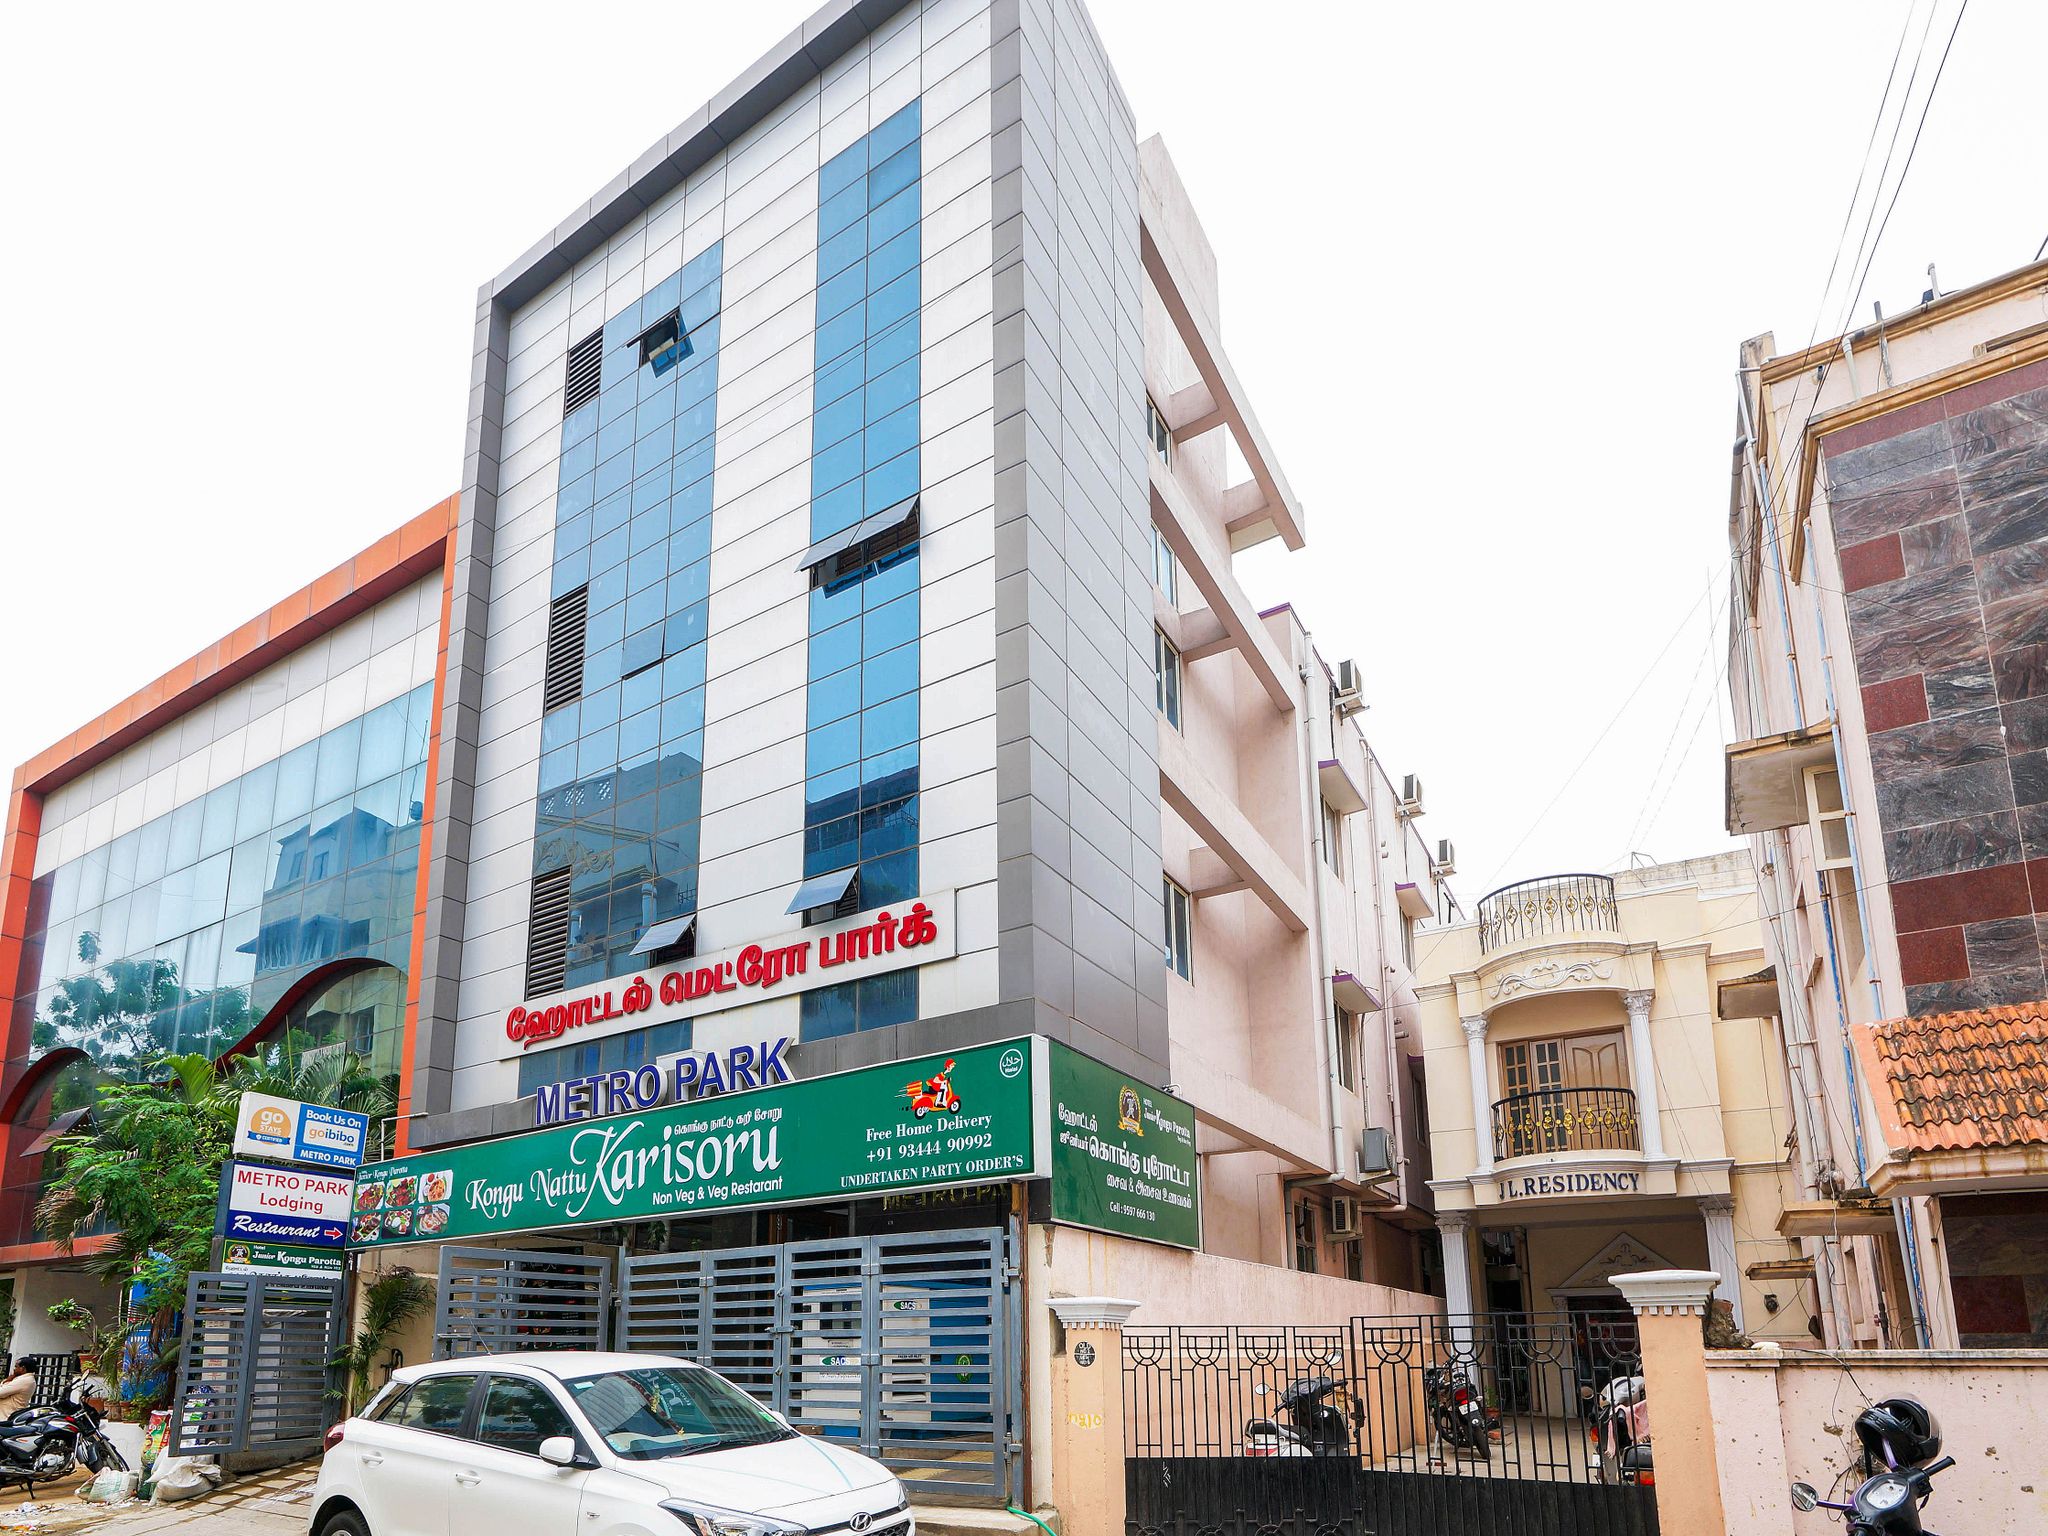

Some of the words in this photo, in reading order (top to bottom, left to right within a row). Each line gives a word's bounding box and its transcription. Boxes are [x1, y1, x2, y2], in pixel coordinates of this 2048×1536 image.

[505, 976, 653, 1050] ஹோட்டல்
[659, 941, 811, 1006] மெட்ரோ
[818, 902, 938, 968] பார்க்
[536, 1064, 666, 1125] METRO
[674, 1037, 795, 1100] PARK
[259, 1124, 282, 1135] STAYS
[260, 1110, 284, 1125] go
[306, 1109, 332, 1123] Book
[333, 1113, 346, 1126] Us
[347, 1117, 362, 1128] On
[866, 1127, 892, 1142] Free
[895, 1122, 933, 1139] Home
[937, 1114, 993, 1133] Delivery
[308, 1127, 355, 1143] goibibo
[866, 1147, 893, 1163] +91
[898, 1140, 941, 1158] 93444
[946, 1132, 993, 1152] 90992
[300, 1149, 331, 1162] METRO
[333, 1155, 357, 1166] PARK
[1088, 1135, 1141, 1174] கொங்கு
[464, 1178, 524, 1220] Kongu
[529, 1167, 588, 1207] Nattu
[565, 1120, 784, 1218] Karisoru
[840, 1167, 919, 1188] UNDERTAKEN
[921, 1161, 963, 1180] PARTY
[237, 1170, 300, 1190] METRO
[304, 1179, 349, 1197] PARK
[652, 1190, 674, 1206] Non
[674, 1188, 695, 1205] Veg
[697, 1187, 706, 1200] &
[707, 1184, 728, 1201] Veg
[730, 1175, 784, 1196] Restarant
[259, 1192, 324, 1215] Lodging
[232, 1214, 321, 1239] Restaurant
[252, 1251, 276, 1261] Junior
[277, 1250, 307, 1265] Kongu
[308, 1256, 342, 1266] Parotta
[900, 1301, 917, 1310] SACS
[830, 1356, 851, 1366] SACS
